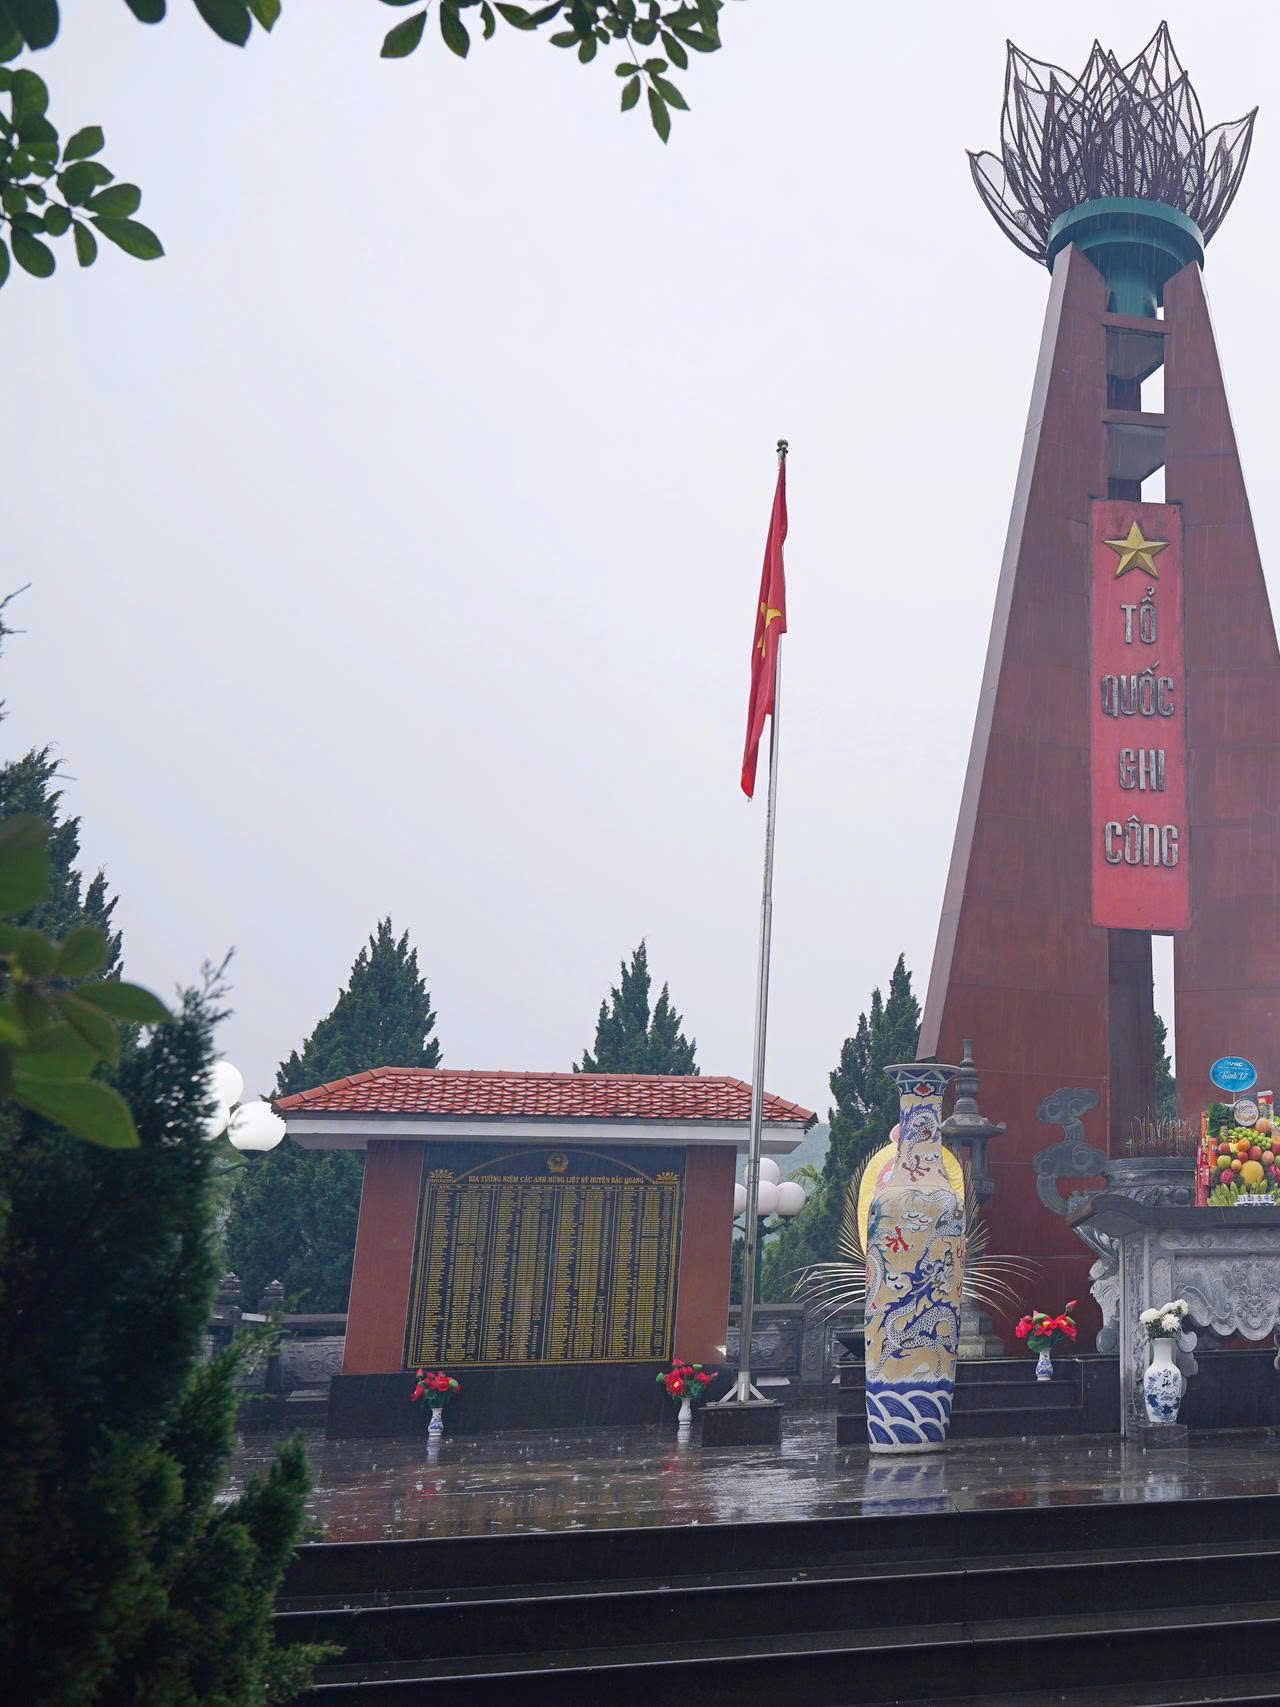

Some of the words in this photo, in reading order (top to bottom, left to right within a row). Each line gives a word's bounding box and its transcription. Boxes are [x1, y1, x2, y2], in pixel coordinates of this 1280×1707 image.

[1120, 585, 1158, 645] TỔ
[1102, 661, 1175, 718] QUỐC
[1119, 748, 1165, 791] GHI
[1105, 815, 1178, 867] CÔNG
